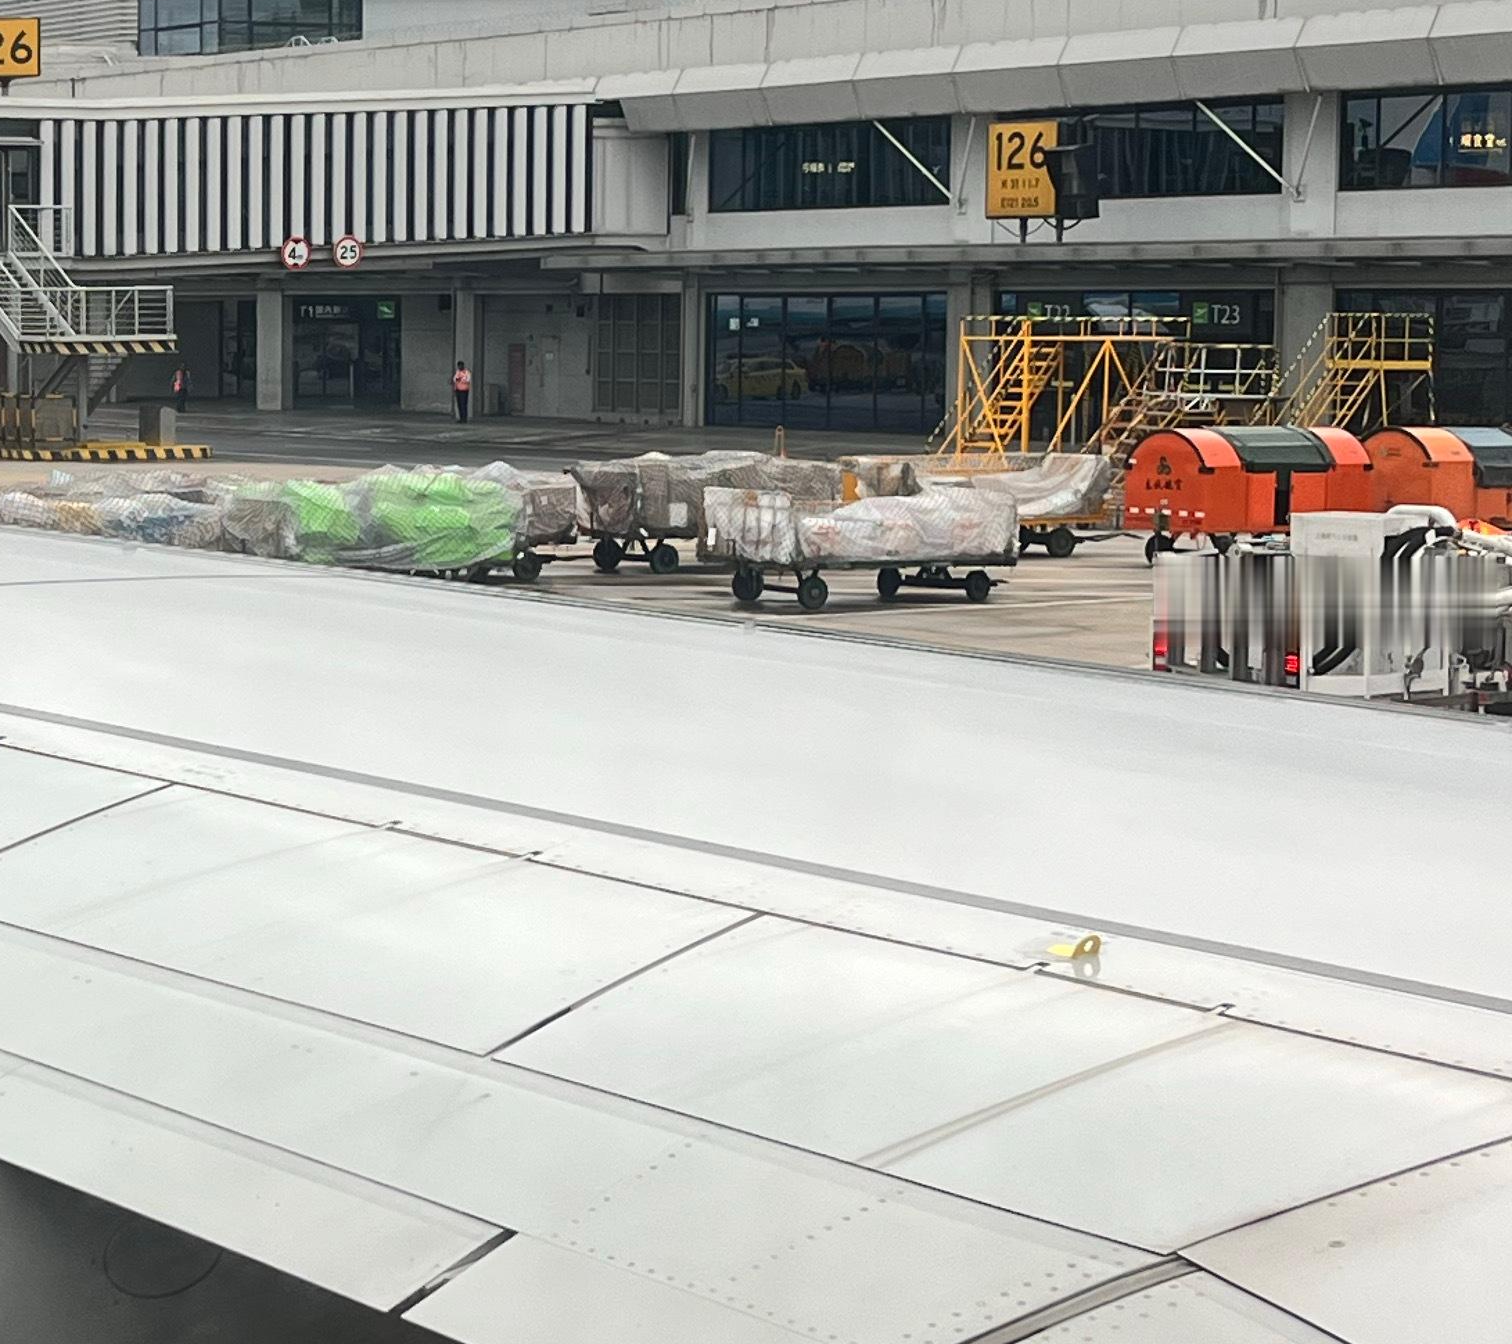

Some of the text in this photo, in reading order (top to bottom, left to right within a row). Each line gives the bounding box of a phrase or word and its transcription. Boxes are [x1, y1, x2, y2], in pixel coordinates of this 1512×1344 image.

[996, 131, 1047, 171] 126
[340, 245, 357, 259] 25
[1210, 305, 1240, 324] T23
